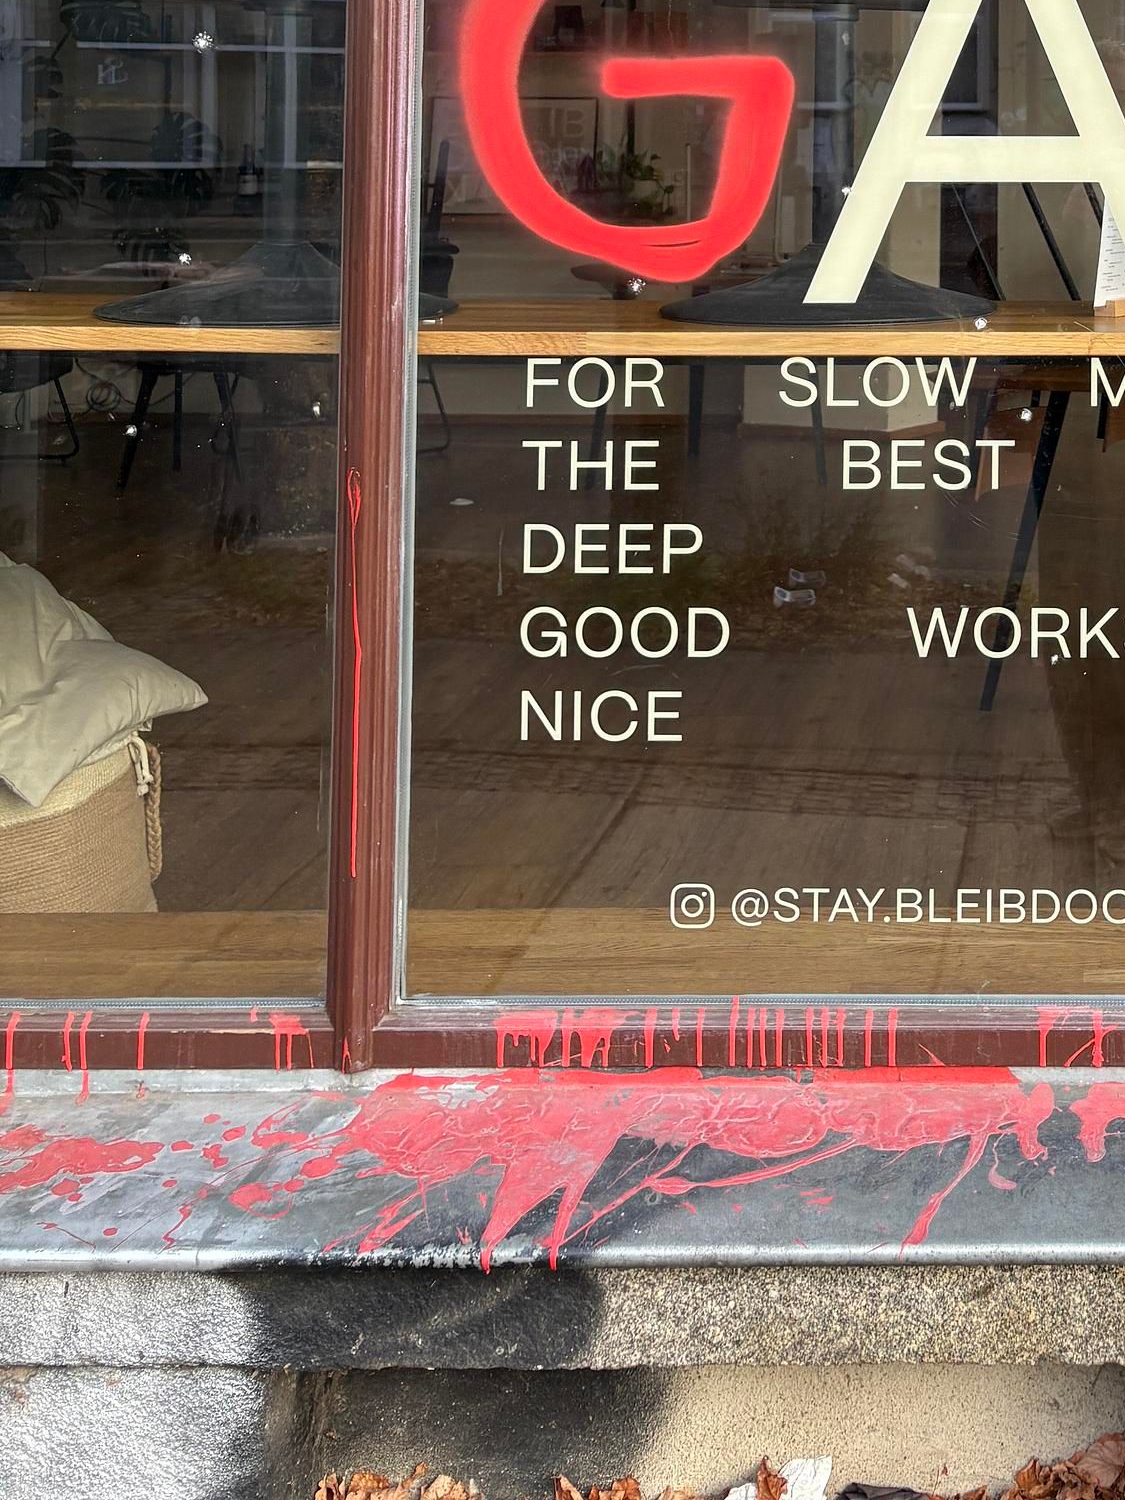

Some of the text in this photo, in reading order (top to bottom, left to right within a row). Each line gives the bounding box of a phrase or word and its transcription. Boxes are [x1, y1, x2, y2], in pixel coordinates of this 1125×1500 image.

[526, 357, 665, 408] FOR
[777, 356, 978, 408] SLOW
[522, 440, 660, 491] THE
[842, 439, 1016, 491] BEST
[523, 523, 704, 574] DEEP
[519, 606, 730, 658] GOOD
[519, 690, 683, 742] NICE
